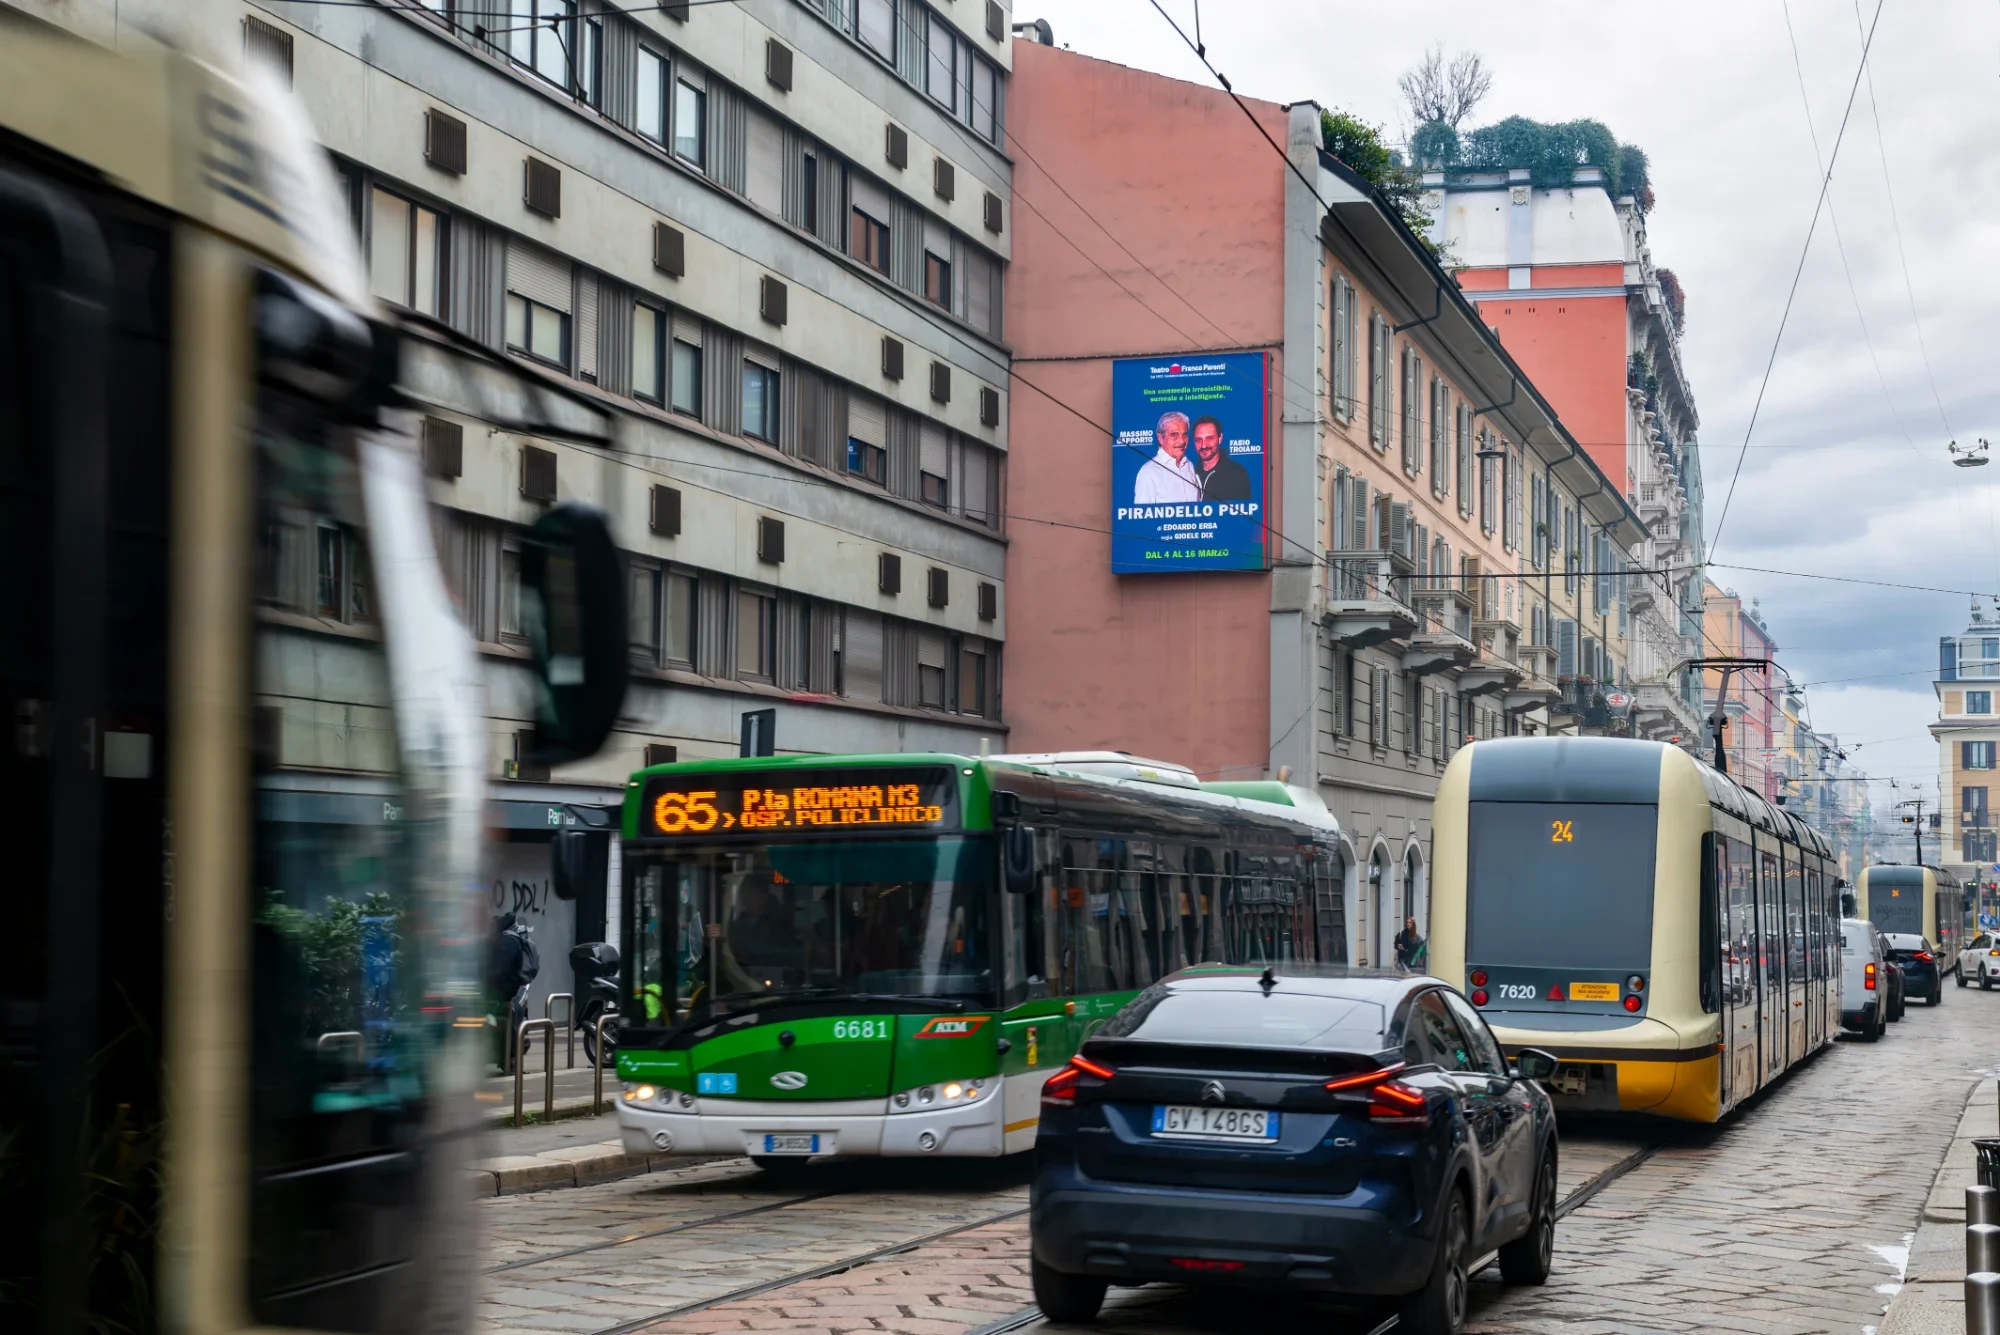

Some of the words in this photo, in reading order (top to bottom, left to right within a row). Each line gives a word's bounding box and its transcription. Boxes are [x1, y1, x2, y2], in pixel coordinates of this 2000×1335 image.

[1203, 363, 1226, 371] Parenti
[1157, 387, 1191, 395] commedia
[1192, 385, 1233, 393] irresistibile,
[1185, 393, 1225, 401] intelligente.
[1119, 430, 1154, 438] MASSIMO
[1229, 445, 1261, 453] TROIANO
[1117, 505, 1213, 520] PIRANDELLO
[1218, 503, 1259, 517] PULP
[1163, 523, 1197, 531] EDOARDO
[1145, 551, 1162, 559] DAL
[1164, 550, 1170, 558] 4
[1172, 550, 1183, 558] AL
[1185, 550, 1196, 558] 16
[1198, 548, 1229, 557] MARZO
[742, 788, 790, 811] P.ta
[793, 785, 883, 809] ROMANA
[887, 783, 920, 806] M3
[383, 802, 404, 821] Pam
[547, 808, 566, 825] Pam
[654, 791, 719, 832] 65
[740, 811, 792, 828] OSP.
[795, 806, 943, 826] POLICLINICO
[1551, 820, 1574, 842] 24
[1499, 984, 1536, 1000] 7620
[834, 1020, 888, 1039] 6681
[935, 1021, 968, 1033] ATM
